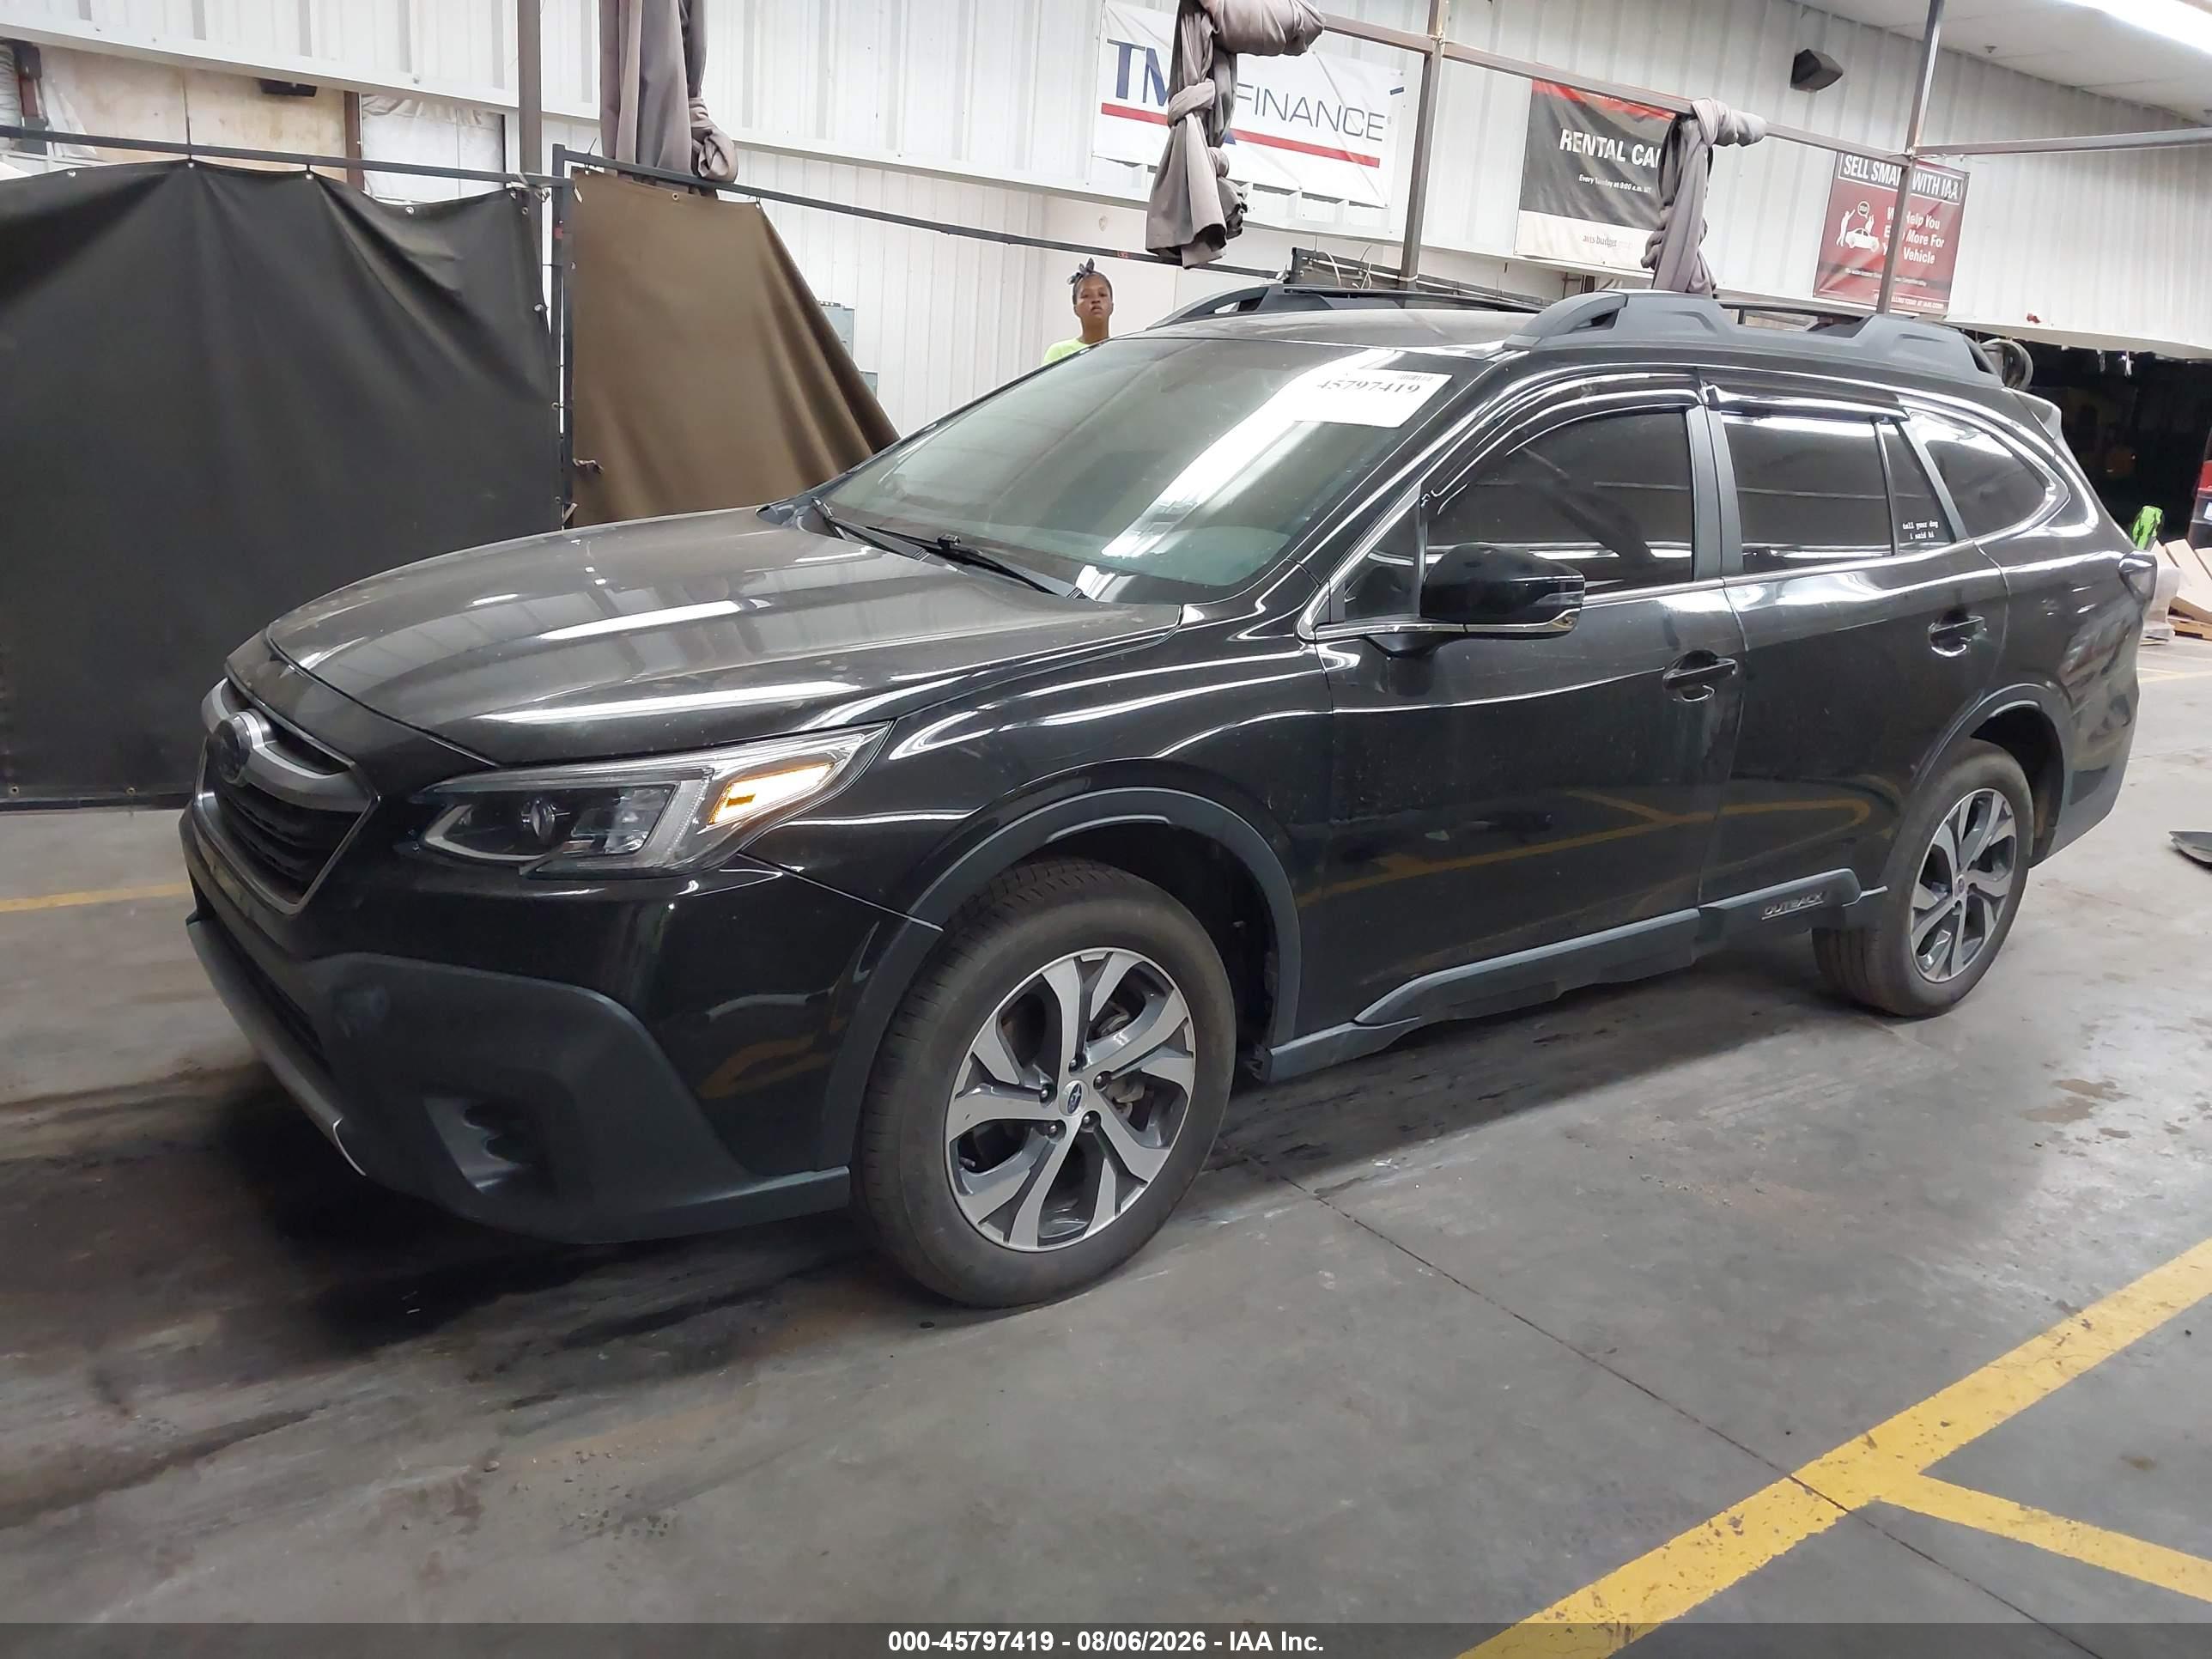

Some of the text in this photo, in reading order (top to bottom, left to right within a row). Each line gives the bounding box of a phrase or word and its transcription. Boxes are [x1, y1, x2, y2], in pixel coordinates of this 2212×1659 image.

[1105, 38, 1169, 107] TM
[1559, 129, 1626, 162] RENTAL
[1844, 154, 1960, 200] SELL SMA WITH IAA
[1925, 214, 1942, 230] You
[1905, 229, 1929, 246] More
[1930, 234, 1945, 248] For
[1903, 246, 1936, 264] Vehicle
